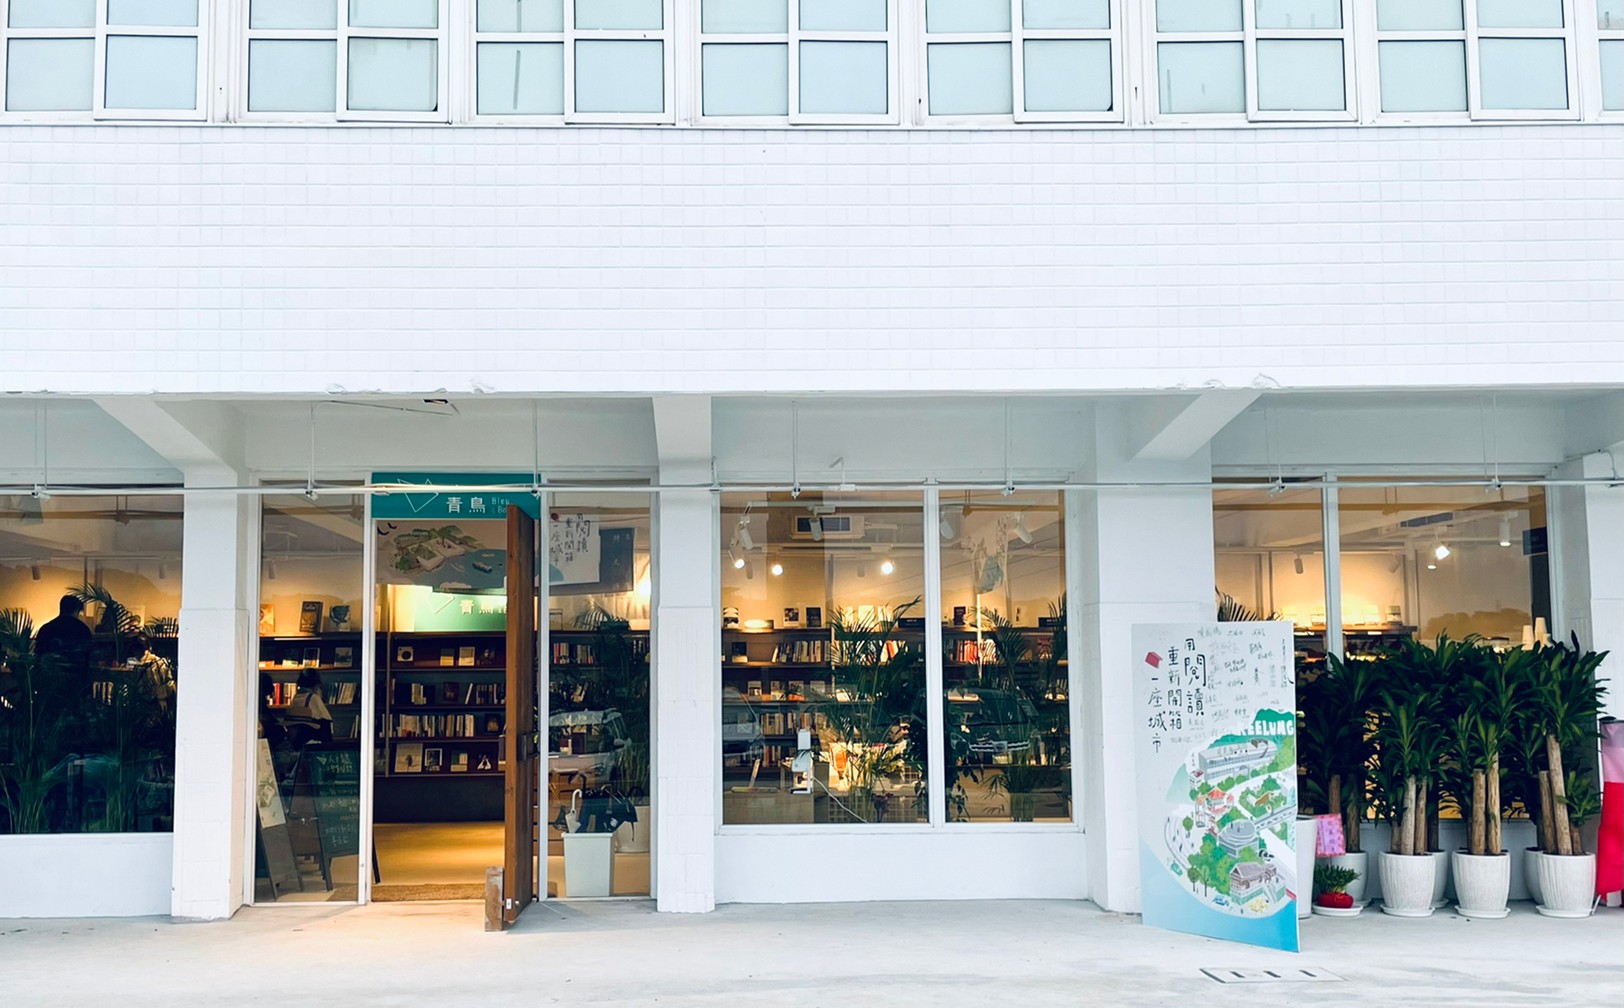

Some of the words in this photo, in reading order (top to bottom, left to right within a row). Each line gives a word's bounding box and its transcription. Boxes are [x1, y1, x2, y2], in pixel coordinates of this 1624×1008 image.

[446, 497, 486, 514] 青鳥
[1148, 677, 1167, 753] 一座城市
[1168, 646, 1182, 730] 重新開箱
